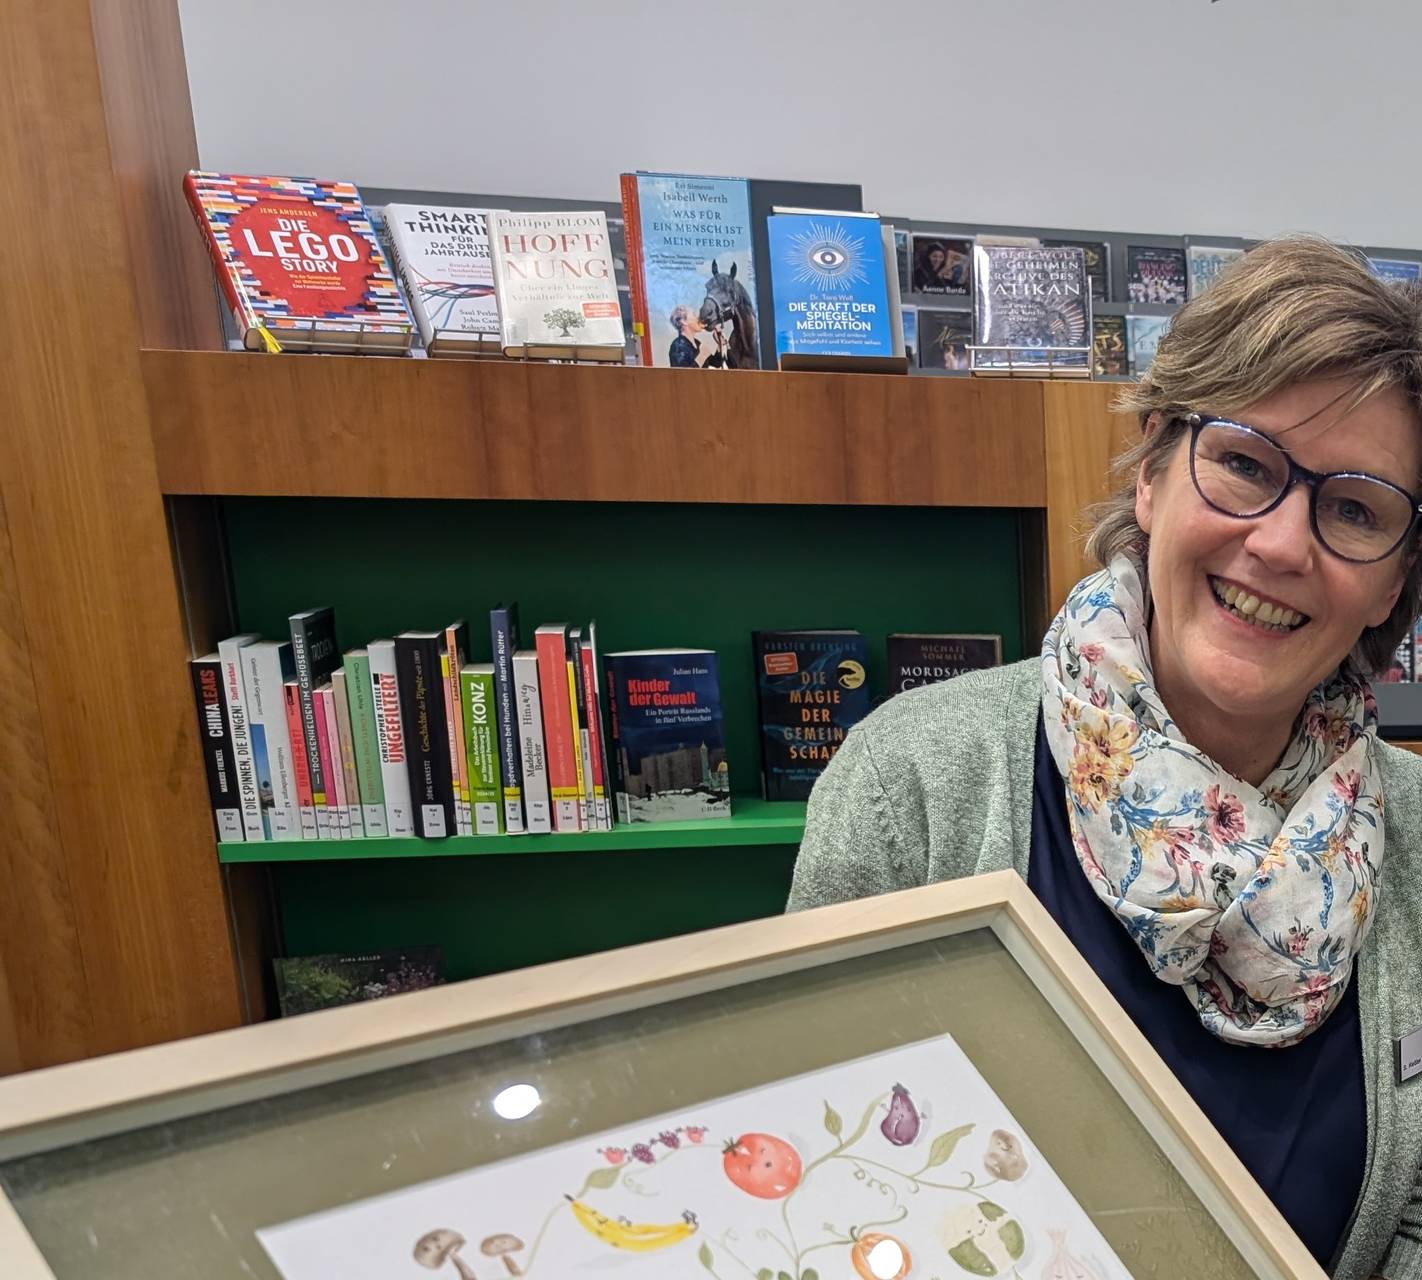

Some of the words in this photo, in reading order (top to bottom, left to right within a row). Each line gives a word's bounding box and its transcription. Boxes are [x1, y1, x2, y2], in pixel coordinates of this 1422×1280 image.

[663, 192, 696, 203] Isabell
[698, 192, 728, 204] Werth
[260, 207, 278, 215] JENS
[279, 208, 318, 217] ANDERSEN
[418, 211, 487, 224] SMART
[673, 209, 696, 219] WAS
[700, 209, 721, 220] FÜR
[277, 218, 310, 232] DIE
[498, 217, 551, 230] Philipp
[556, 217, 602, 228] BLOM
[653, 223, 672, 232] EIN
[675, 223, 722, 234] MENSCH
[725, 225, 744, 235] IST
[242, 228, 359, 262] LEGO
[451, 234, 474, 243] FÜR
[504, 234, 604, 253] HOFF
[663, 236, 691, 246] MEIN
[695, 238, 735, 248] PFERD?
[281, 258, 338, 273] STORY
[506, 259, 609, 280] NUNG
[1006, 261, 1079, 270] GEHEIMEN
[1050, 272, 1074, 281] DES
[788, 302, 808, 311] DIE
[810, 302, 850, 313] KRAFT
[852, 303, 876, 313] DER
[806, 312, 860, 322] SPIEGEL-
[796, 321, 872, 331] MEDITATION
[920, 645, 965, 653] MICHAEL
[294, 633, 309, 689] GEMÜSEBEET
[922, 654, 966, 662] SOMMER
[499, 656, 507, 682] Martin
[627, 679, 671, 692] Kinder
[801, 672, 827, 685] DIE
[415, 676, 427, 701] Päpste
[303, 695, 311, 706] IM
[372, 686, 383, 711] STEELE
[470, 682, 486, 724] KONZ
[629, 692, 651, 706] der
[653, 691, 696, 706] Gewalt
[789, 690, 841, 704] MAGIE
[503, 693, 511, 723] Hunden
[645, 709, 657, 717] Ein
[680, 706, 711, 715] Russlands
[230, 705, 248, 739] JUNGEN!
[380, 673, 405, 763] UNGEFILTERT
[655, 716, 662, 724] in
[663, 716, 677, 724] fünf
[677, 714, 712, 724] Verbrechen
[801, 709, 831, 722] DER
[376, 714, 389, 763] CHRISTOPHER
[420, 711, 430, 752] Geschichte
[304, 708, 320, 772] TROCKENHELDEN
[237, 740, 249, 756] DIE
[527, 736, 535, 778] Madeleine
[535, 743, 543, 770] Becker
[240, 757, 255, 793] SPINNEN,
[245, 795, 257, 810] DIE
